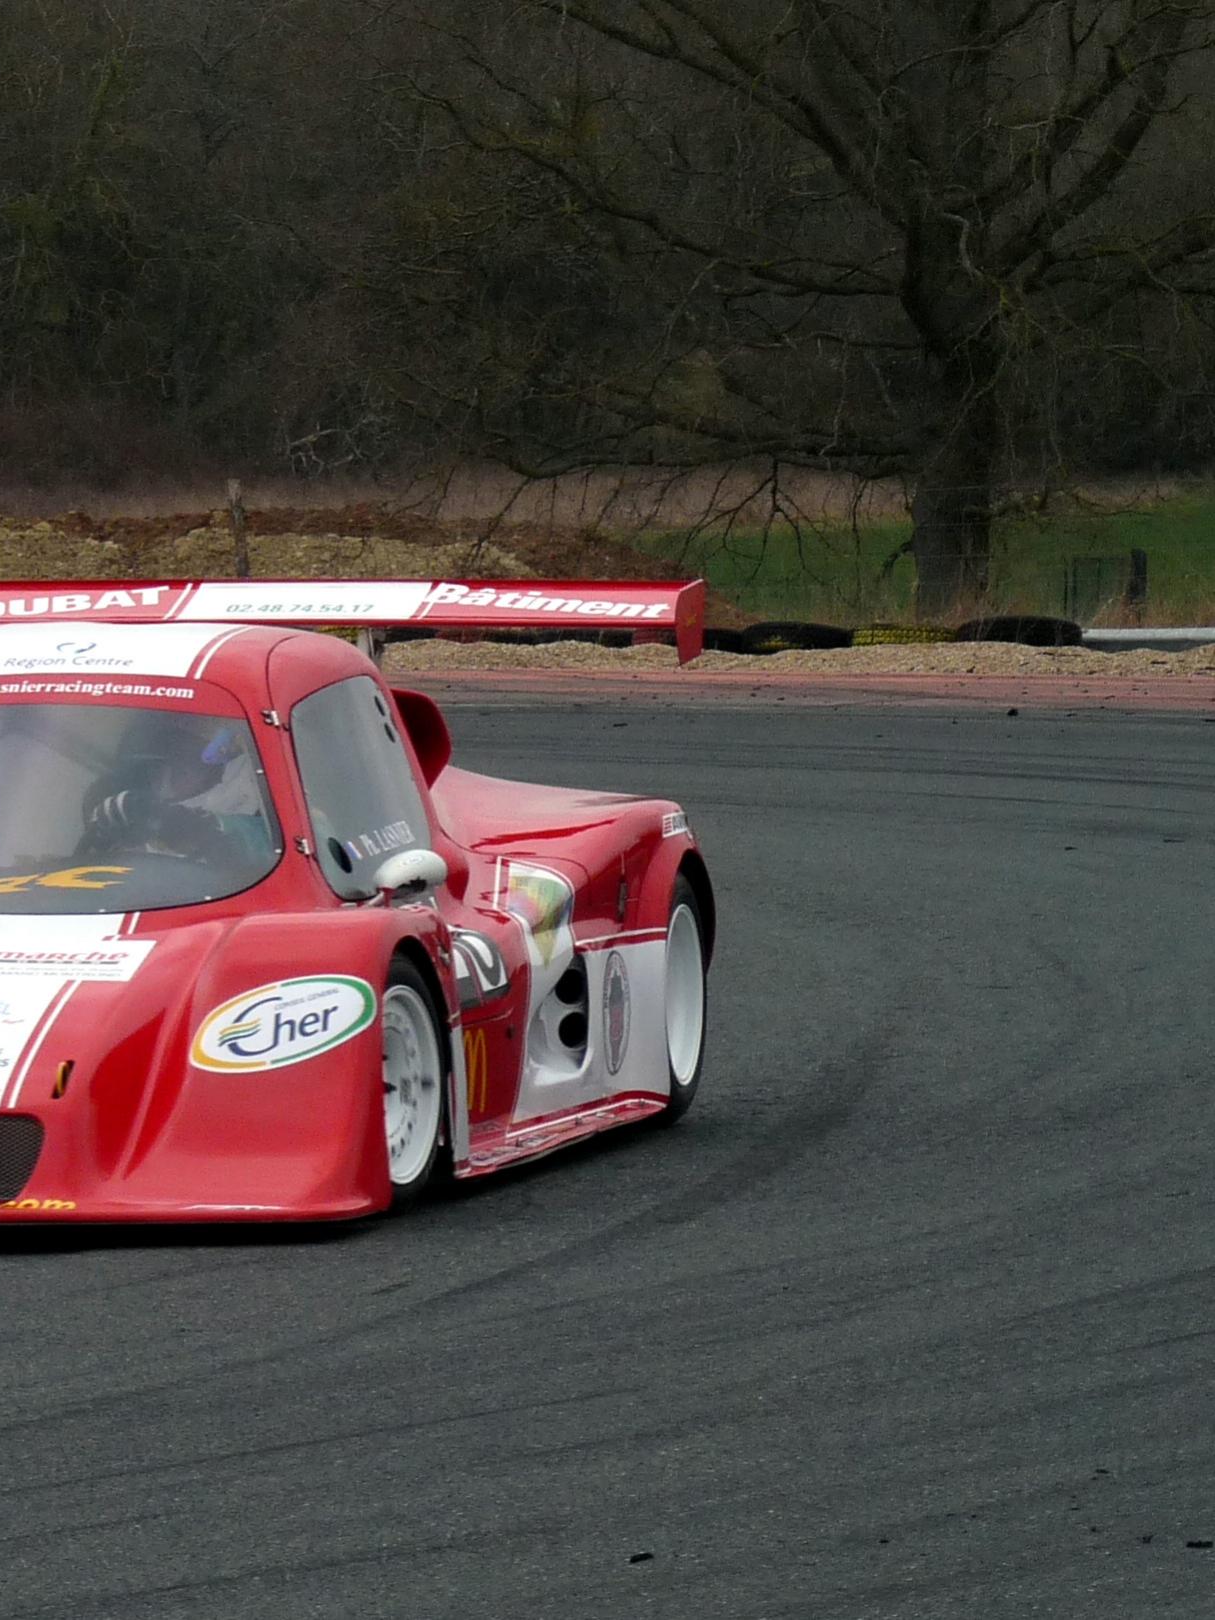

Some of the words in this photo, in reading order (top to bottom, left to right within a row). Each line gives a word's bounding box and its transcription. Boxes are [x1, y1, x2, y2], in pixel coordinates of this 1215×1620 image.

[226, 603, 374, 613] 02.48.74.54.17
[430, 582, 670, 618] Bâtiment
[72, 656, 134, 666] Centre
[218, 997, 338, 1057] Cher
